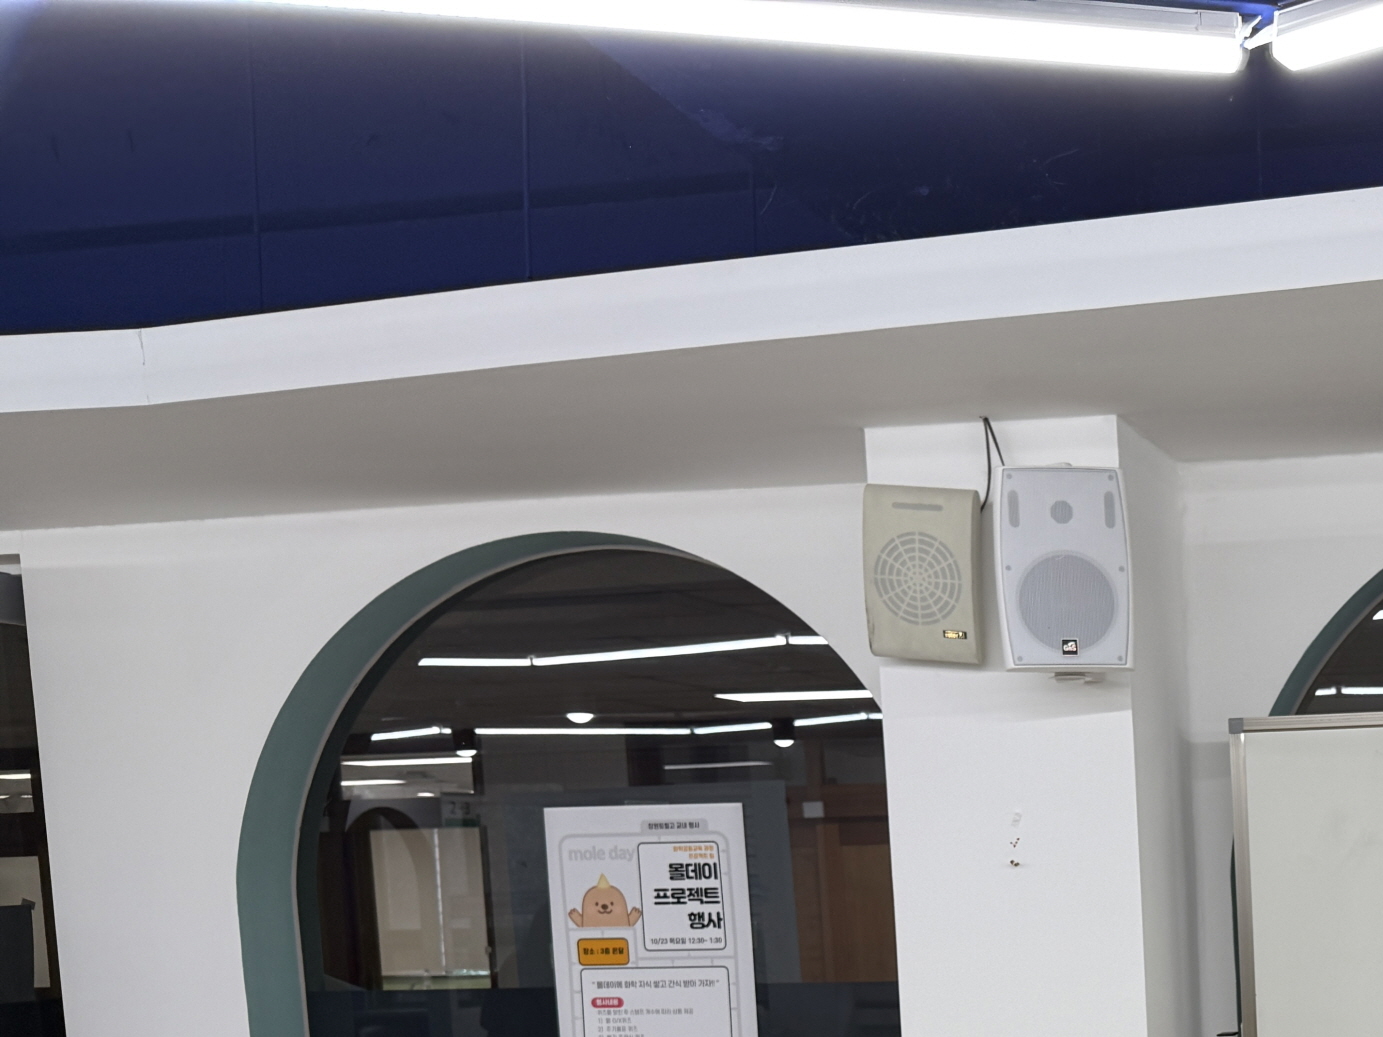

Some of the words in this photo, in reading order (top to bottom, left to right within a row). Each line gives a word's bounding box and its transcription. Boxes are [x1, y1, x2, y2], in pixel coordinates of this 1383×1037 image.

[568, 846, 605, 861] mole
[609, 845, 635, 862] day
[669, 862, 719, 881] 몰데이
[654, 886, 721, 906] 프로젝트
[688, 911, 724, 930] 행사
